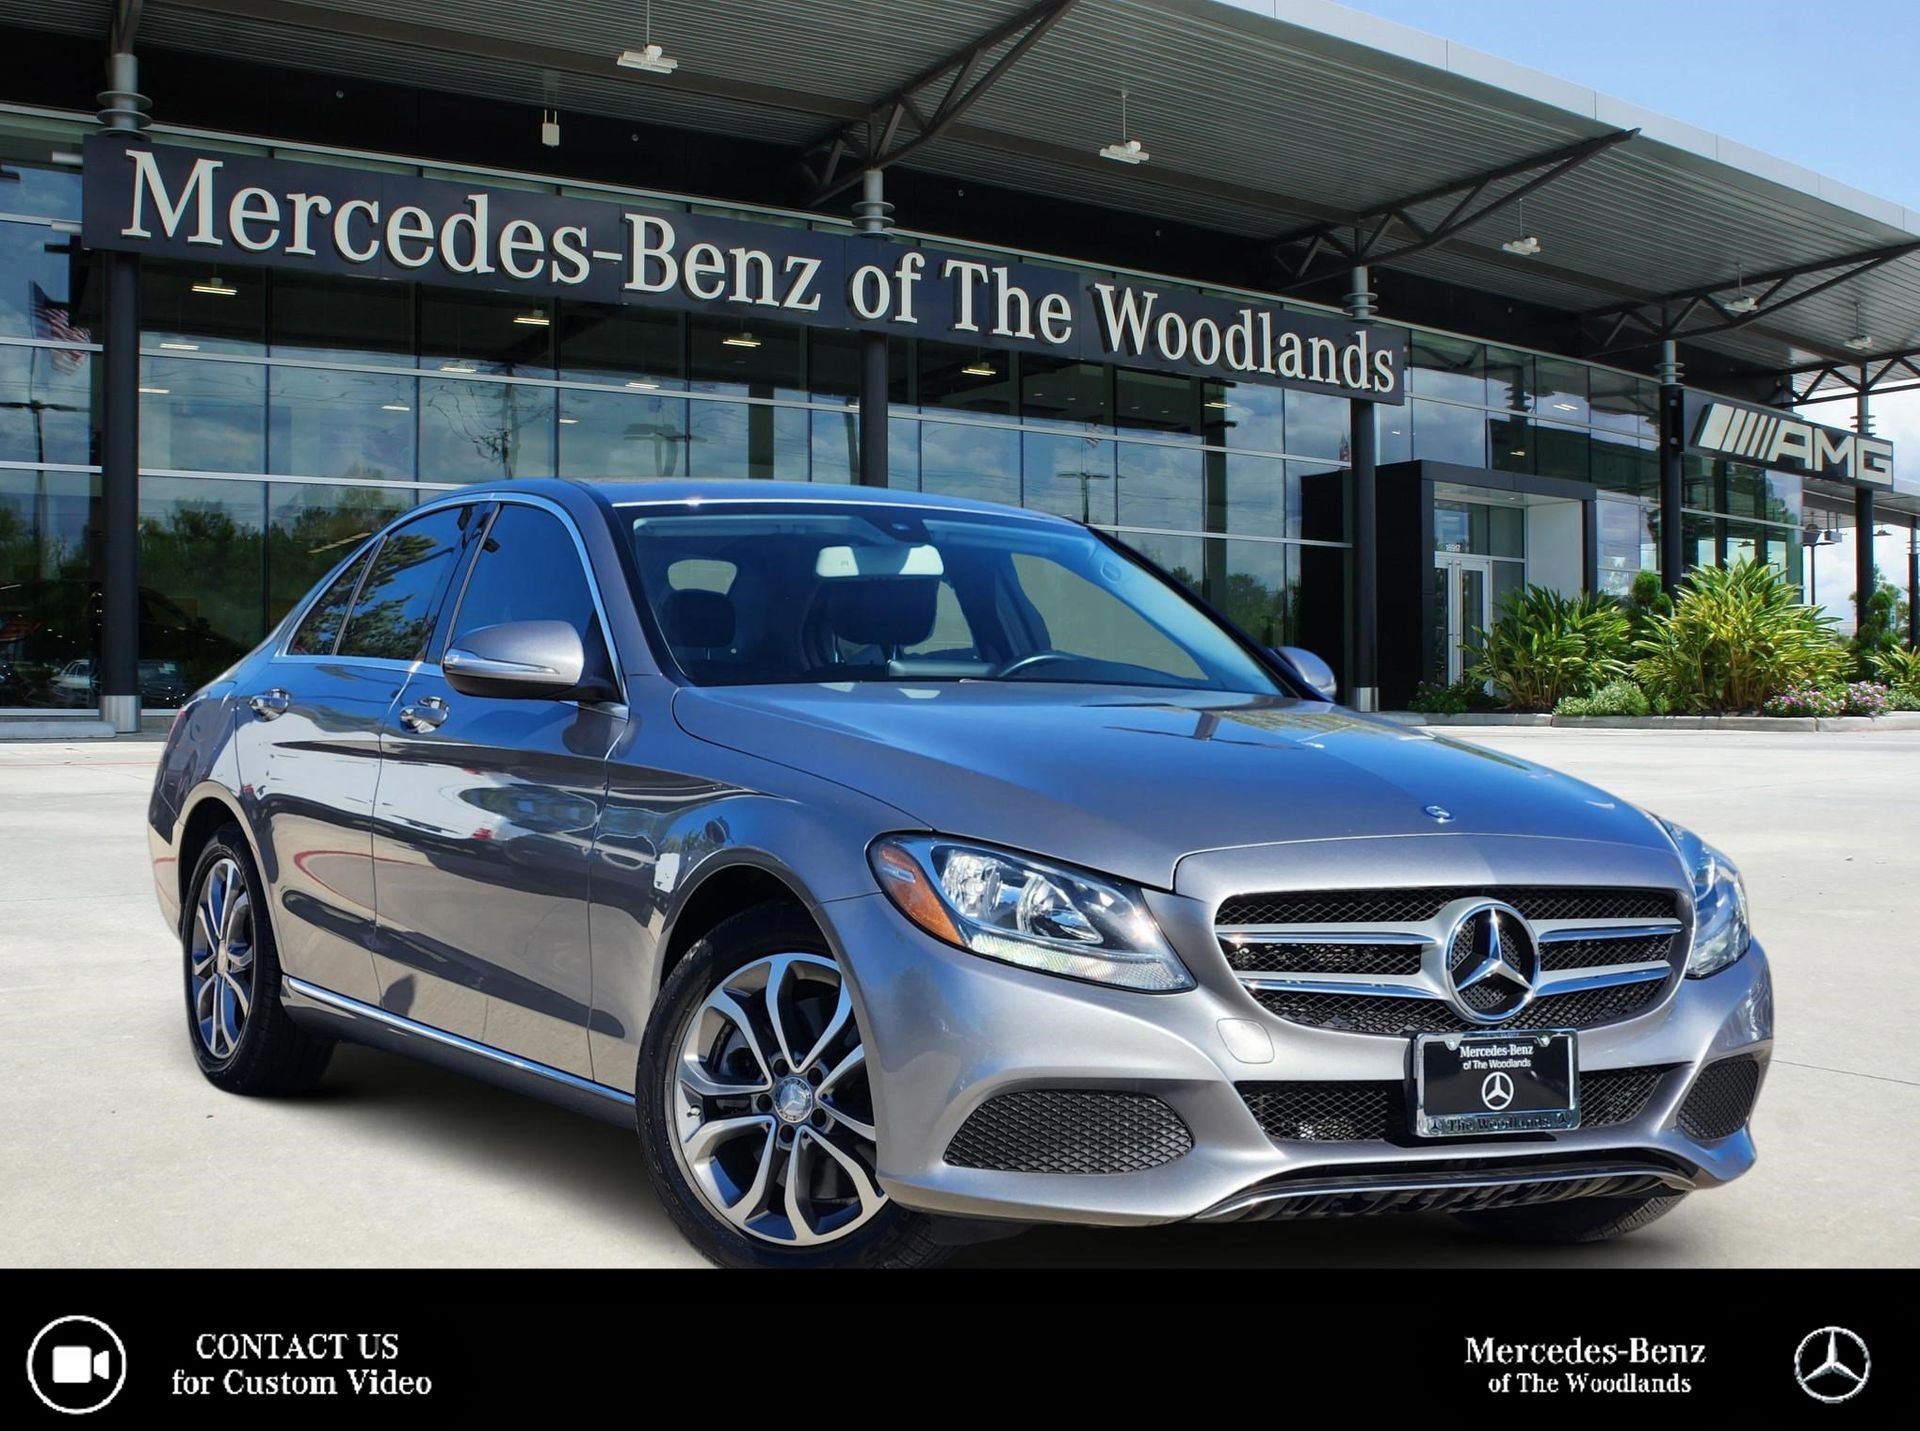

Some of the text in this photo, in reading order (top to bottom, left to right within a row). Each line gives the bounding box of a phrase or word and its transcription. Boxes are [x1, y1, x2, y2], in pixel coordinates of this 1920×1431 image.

[121, 149, 1395, 393] Mercedes-Benz of The Woodlands
[1767, 419, 1893, 486] AMG
[1459, 1045, 1534, 1058] Mercedes-Benz
[1462, 1058, 1532, 1070] of The Woodlands
